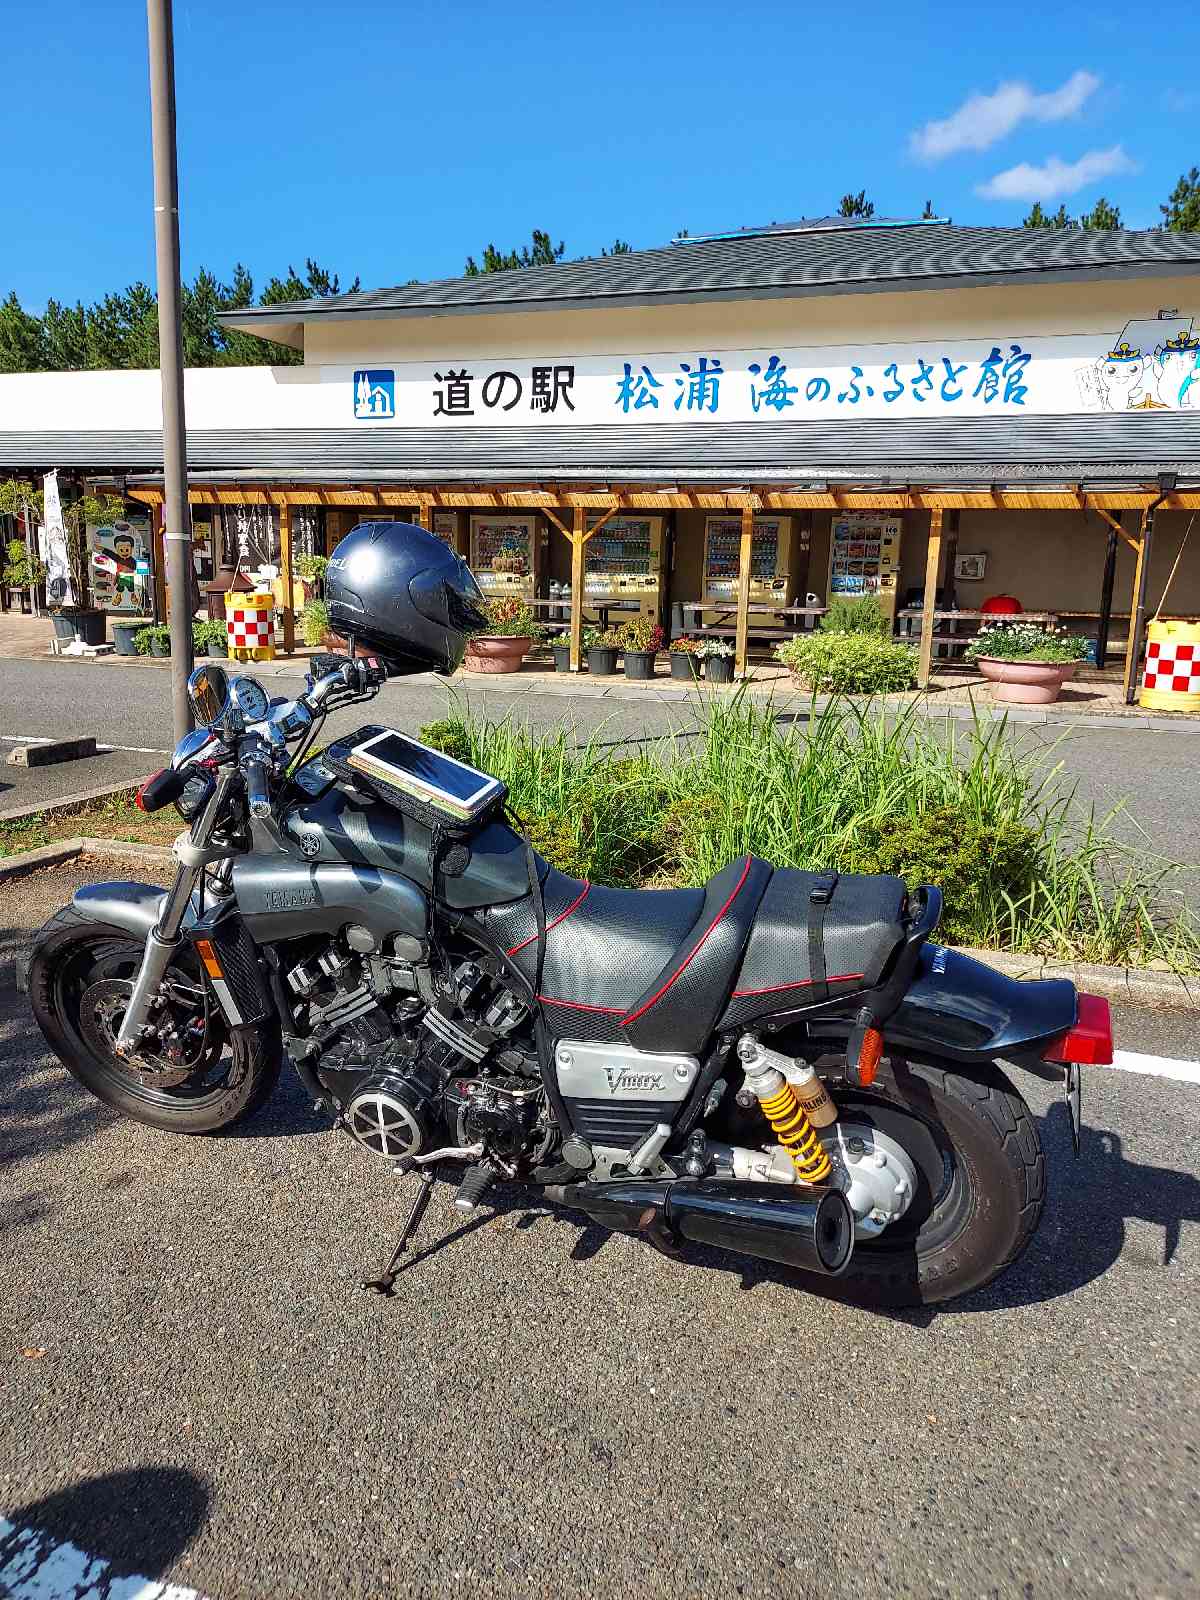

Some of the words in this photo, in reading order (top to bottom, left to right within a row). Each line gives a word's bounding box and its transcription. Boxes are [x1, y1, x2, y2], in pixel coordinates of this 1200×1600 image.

[432, 365, 576, 416] 道の駅
[615, 357, 724, 413] 松浦
[748, 345, 1032, 412] 海のふるさと館
